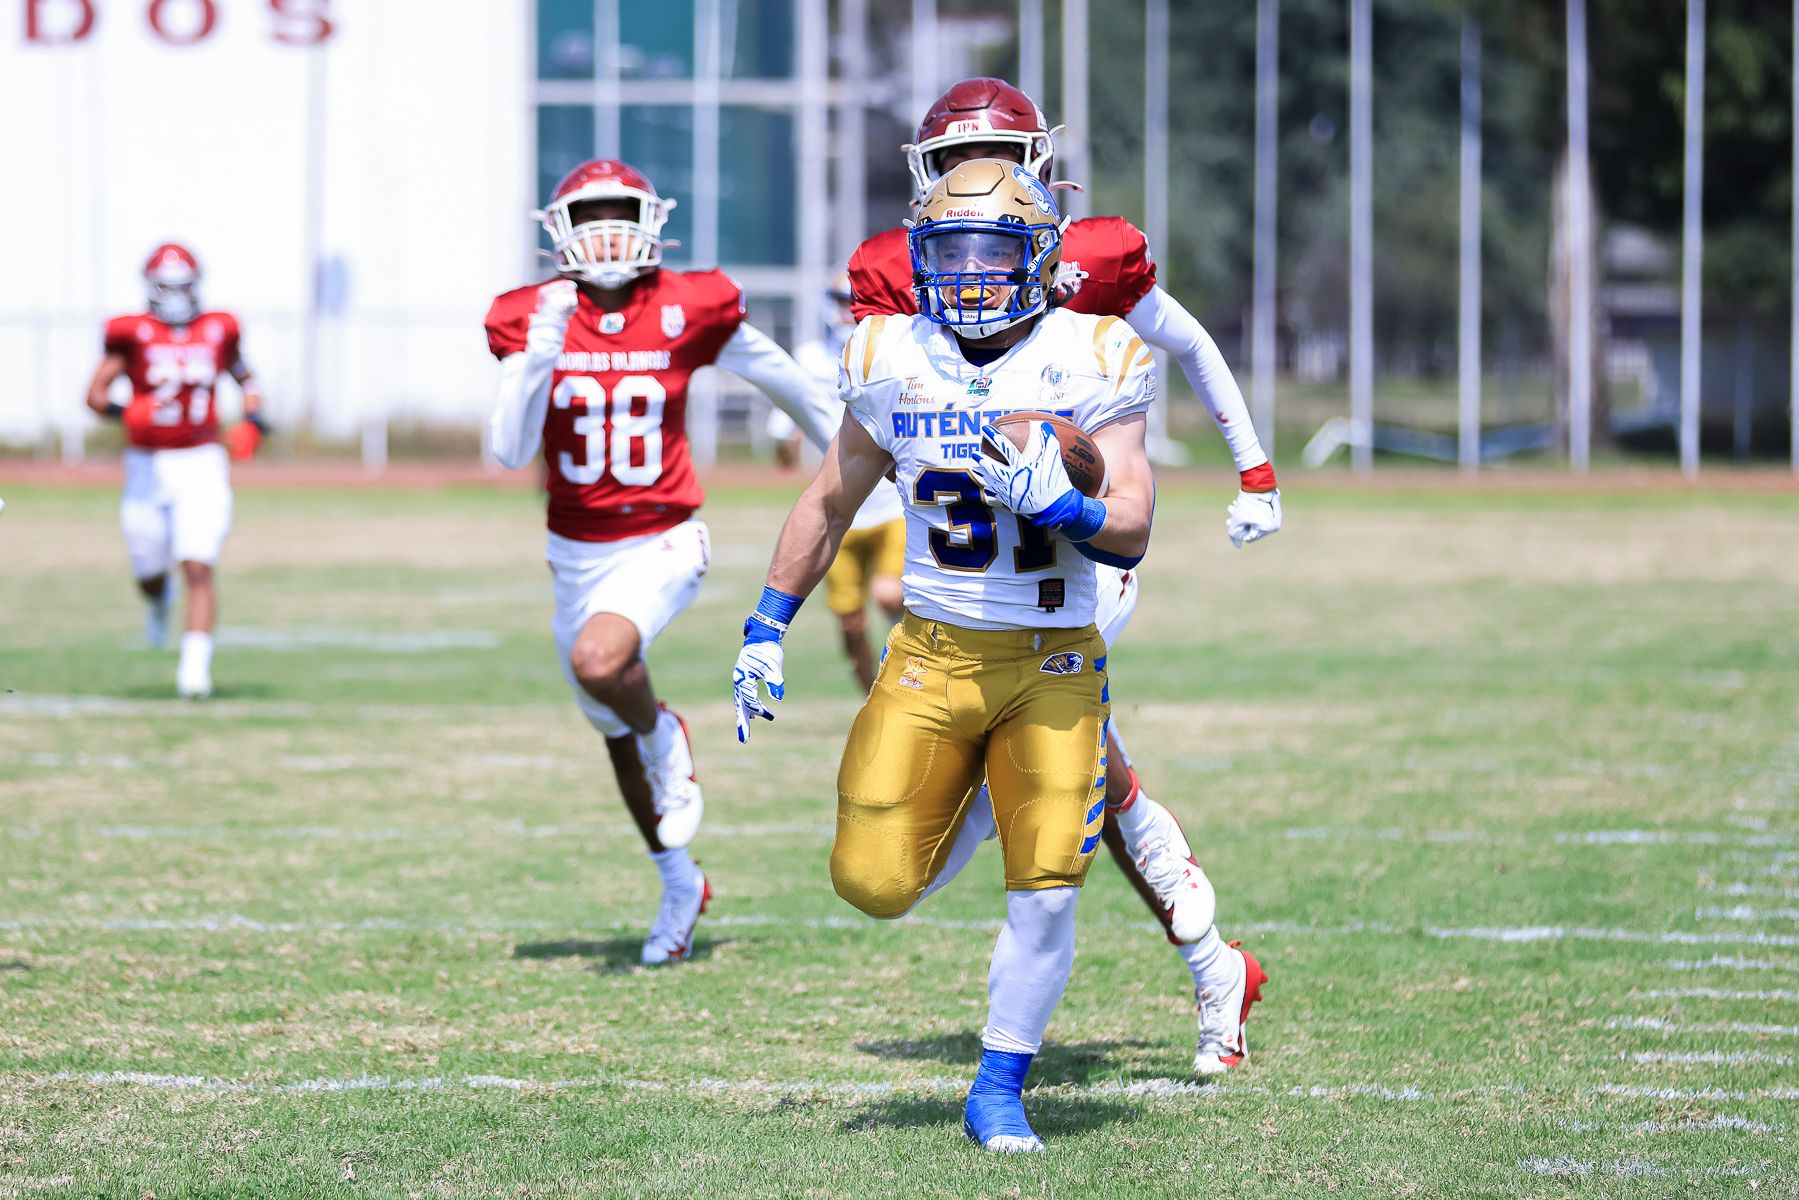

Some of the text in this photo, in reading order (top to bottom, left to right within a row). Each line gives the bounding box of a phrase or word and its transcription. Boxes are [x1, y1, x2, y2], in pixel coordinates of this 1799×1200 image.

[957, 122, 979, 133] IPN
[905, 376, 924, 390] Tim
[552, 375, 667, 487] 38
[913, 466, 1057, 573] 31
